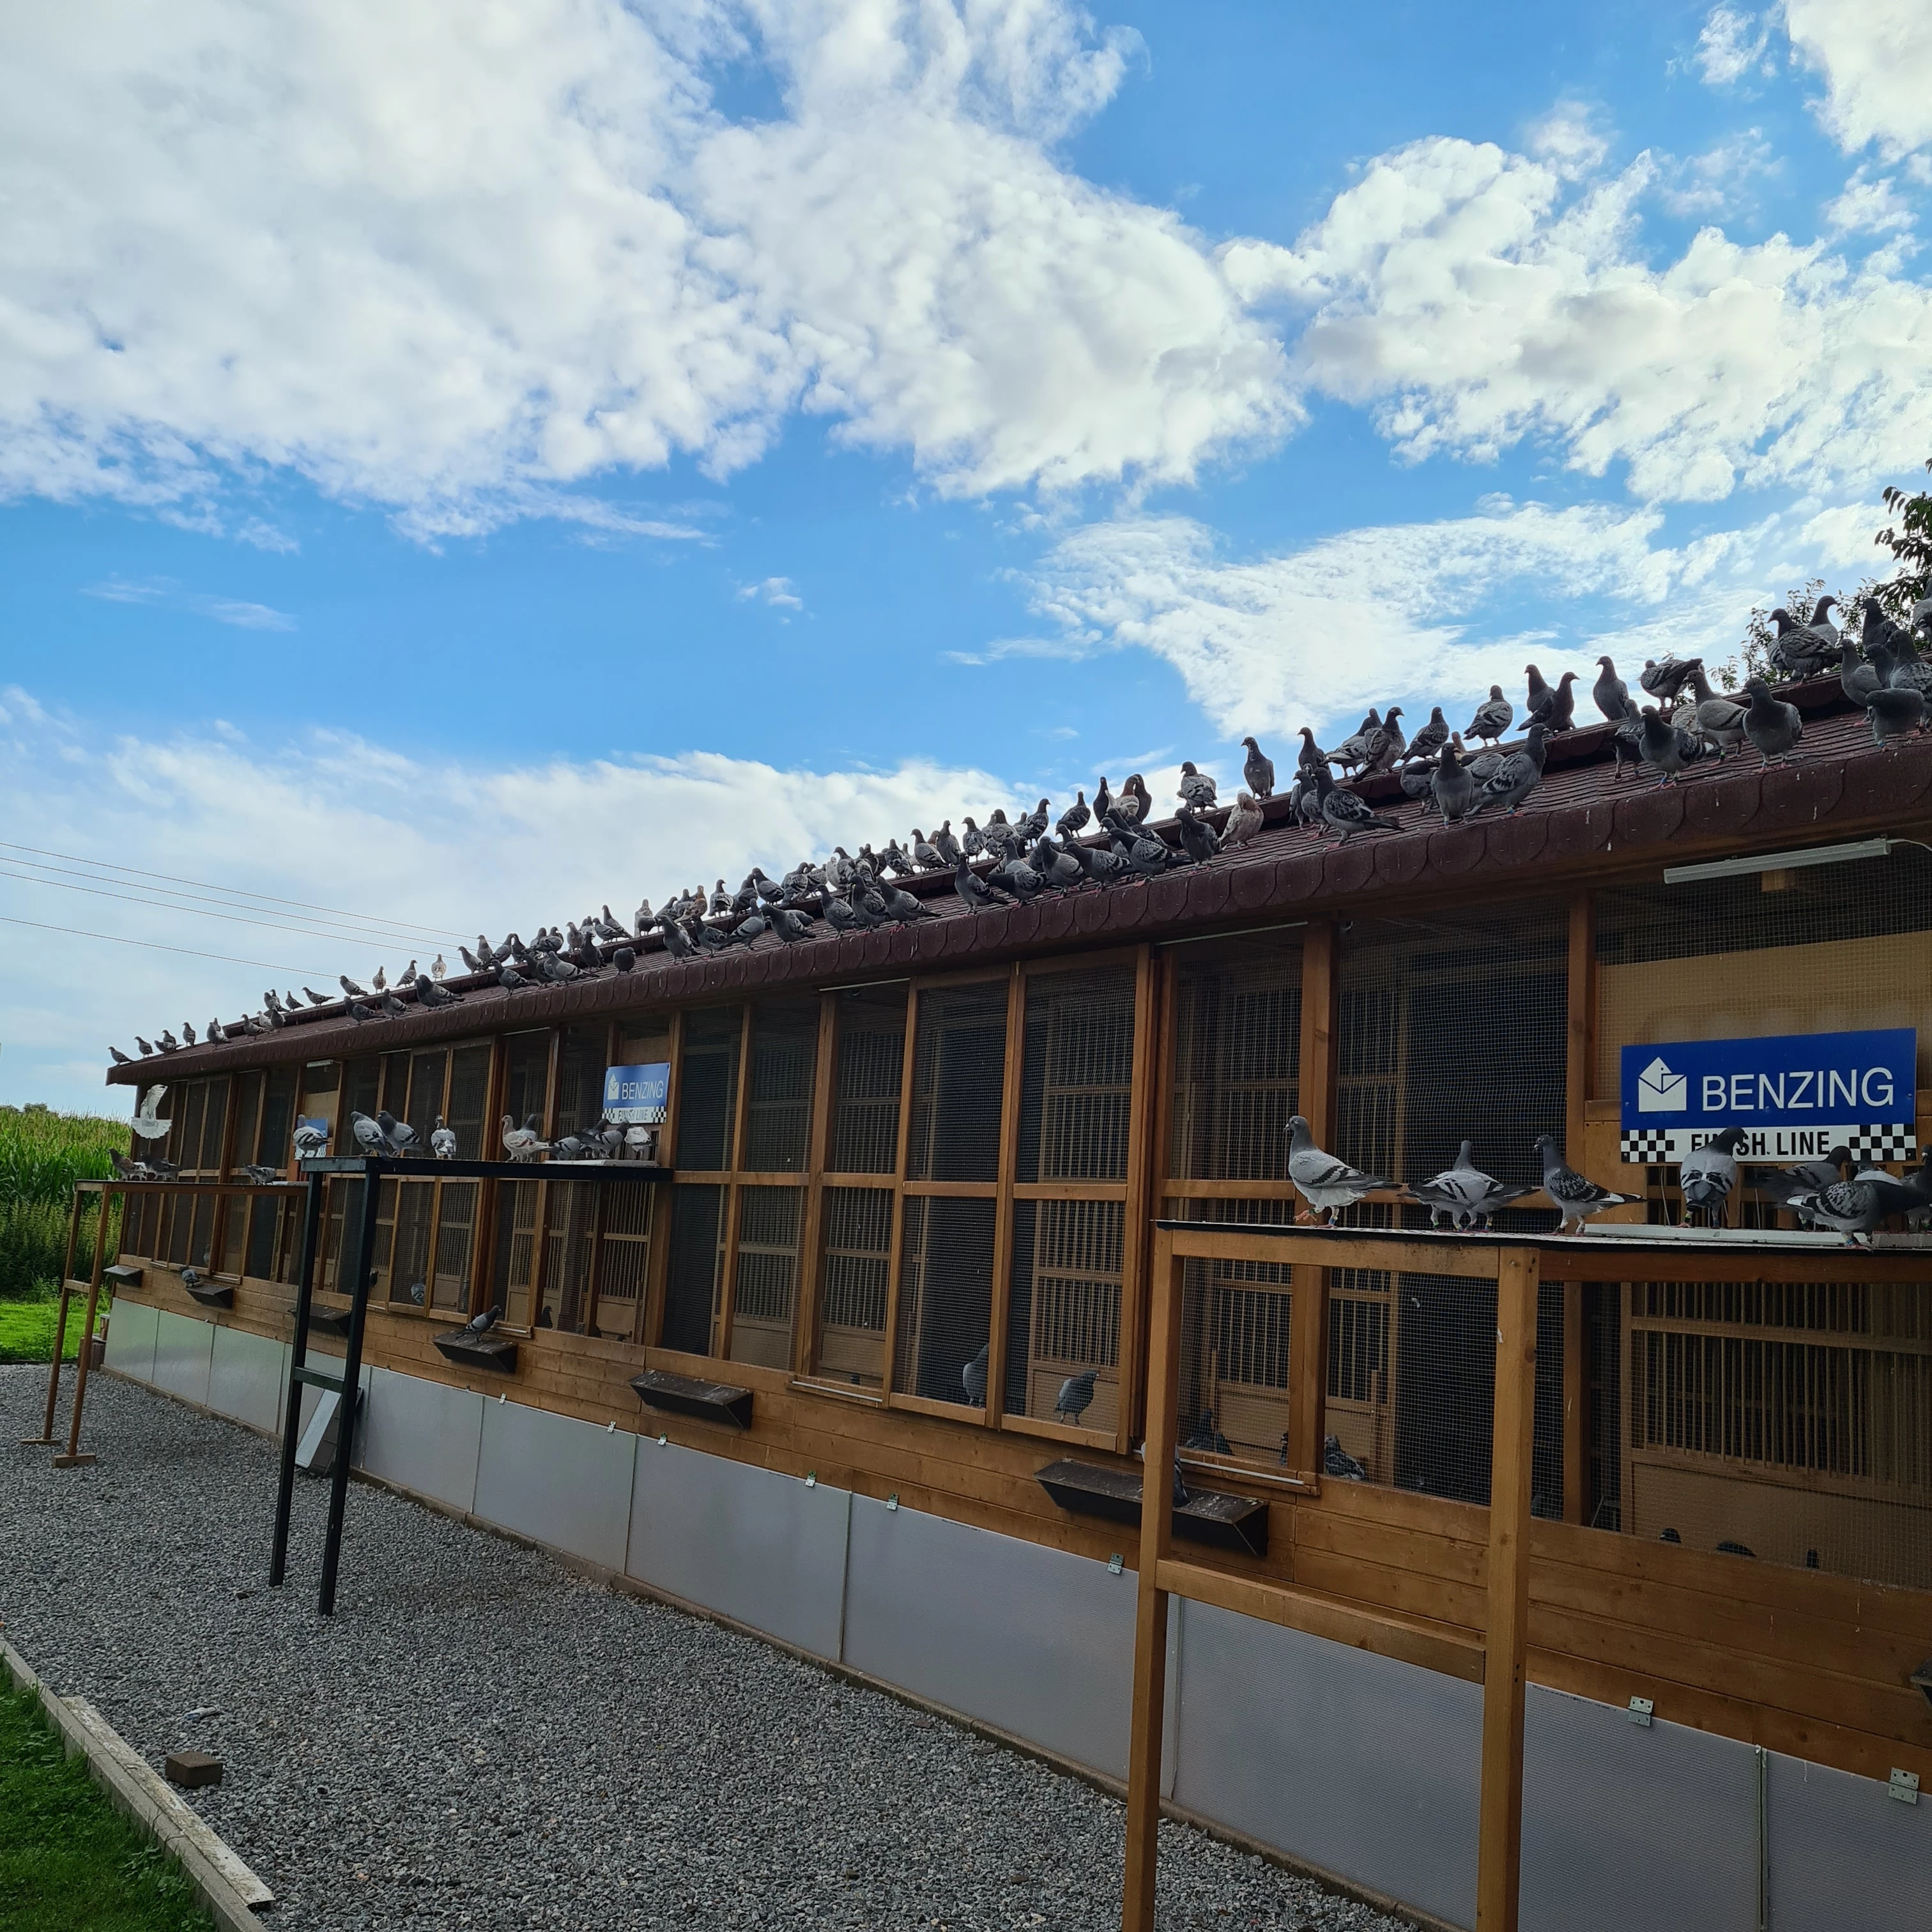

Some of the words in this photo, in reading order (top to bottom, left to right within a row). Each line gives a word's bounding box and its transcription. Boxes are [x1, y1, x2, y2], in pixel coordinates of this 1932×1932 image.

[622, 1080, 663, 1100] BENZING
[1703, 1067, 1894, 1111] BENZING
[1691, 1133, 1765, 1156] FISH
[1777, 1131, 1830, 1155] LINE
